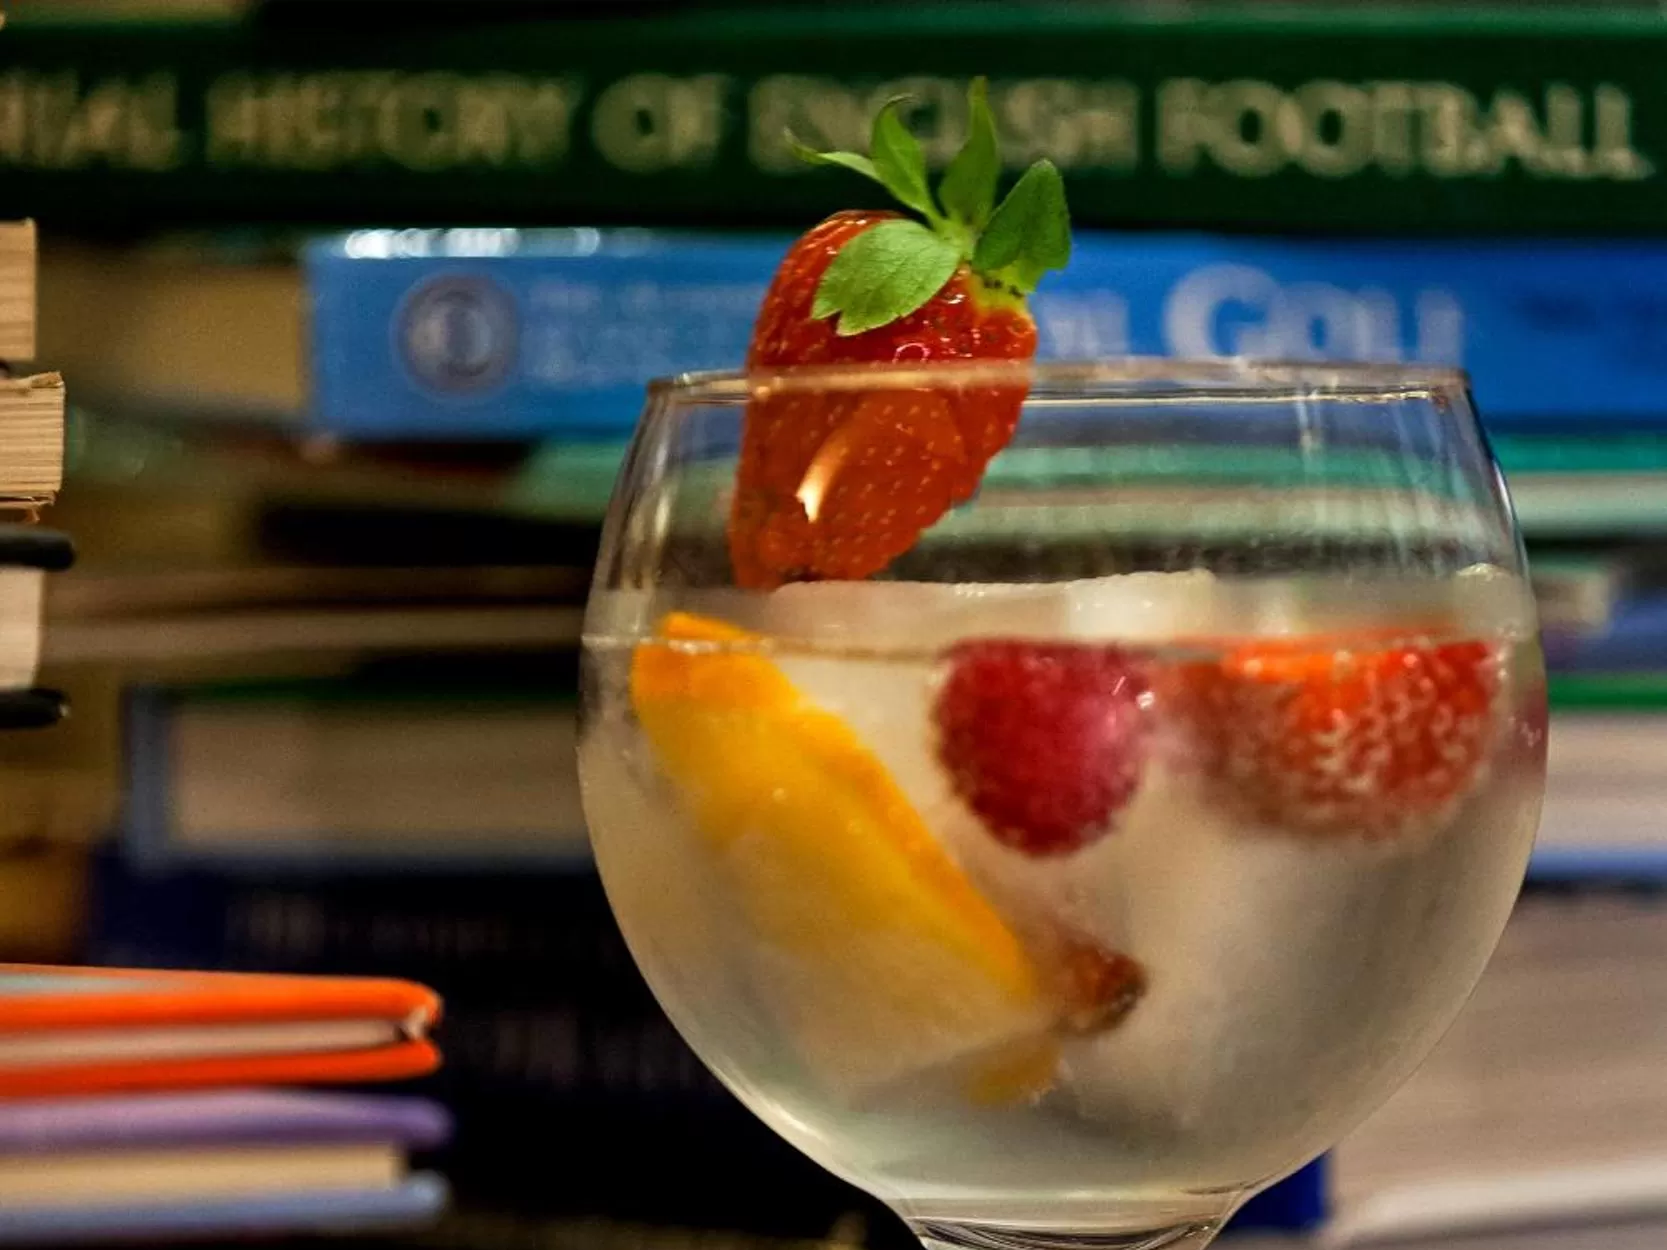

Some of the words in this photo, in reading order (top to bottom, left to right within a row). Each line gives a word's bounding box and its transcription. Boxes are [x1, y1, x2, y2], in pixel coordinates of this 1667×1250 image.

[205, 70, 578, 170] HISTORY
[593, 72, 728, 172] OF
[1156, 78, 1652, 179] FOOTBALL
